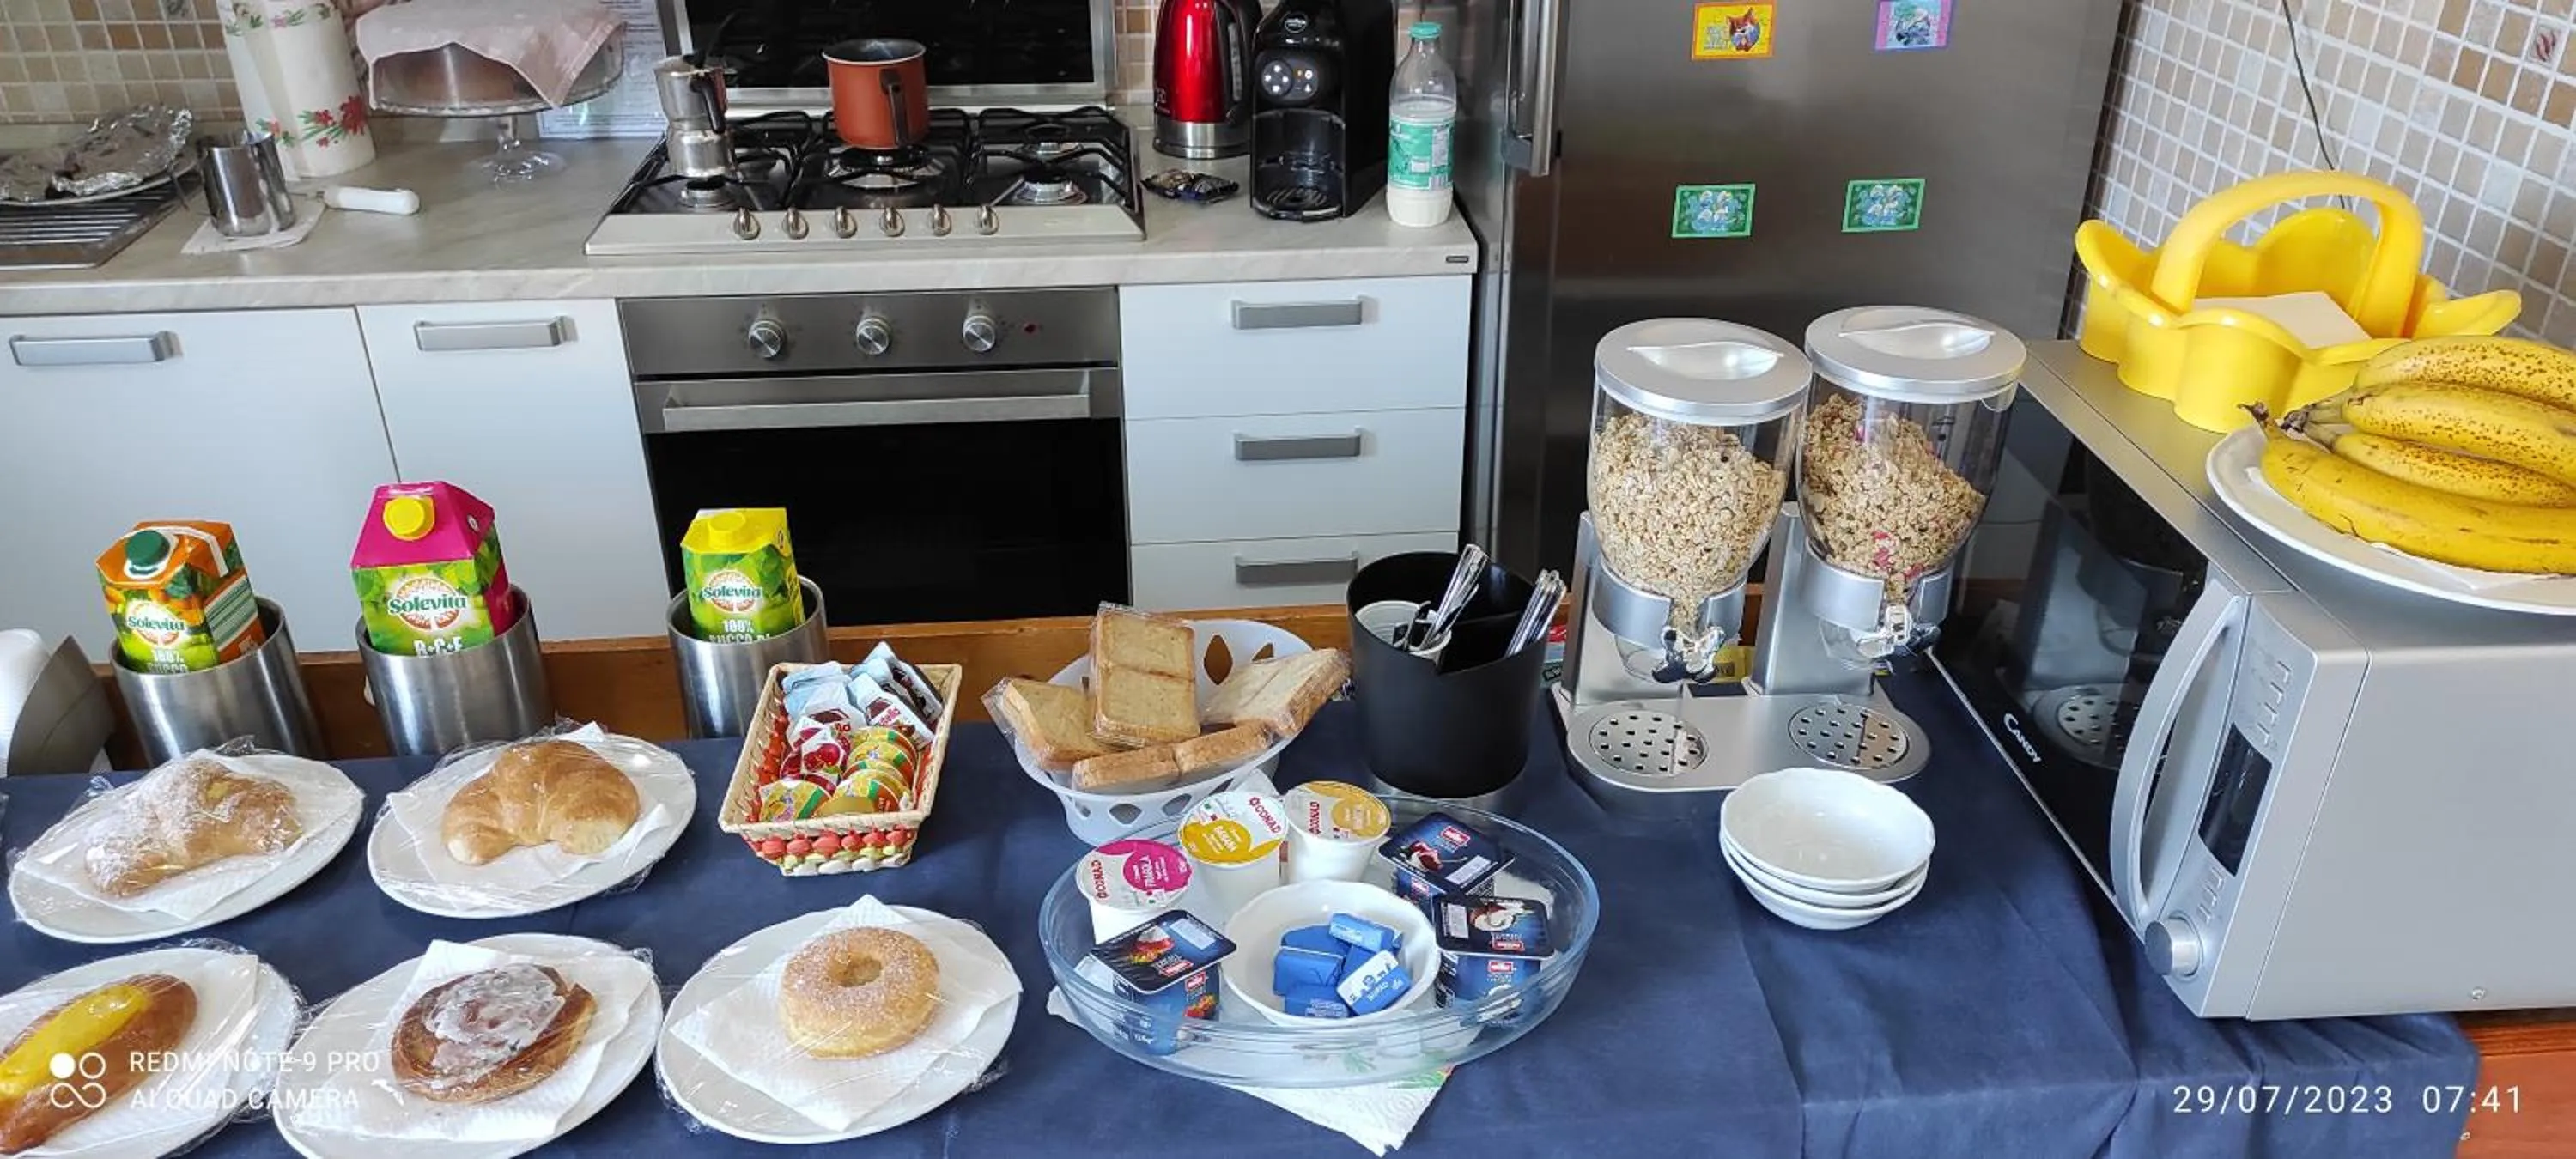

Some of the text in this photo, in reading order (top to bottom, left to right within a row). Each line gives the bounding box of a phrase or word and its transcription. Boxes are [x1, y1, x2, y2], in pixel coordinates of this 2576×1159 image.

[704, 586, 761, 598] Solevita
[389, 592, 466, 614] Solevita
[128, 616, 185, 631] Solevita
[721, 619, 754, 633] 100%
[1255, 804, 1283, 833] CONAD
[1091, 859, 1107, 891] CONAD
